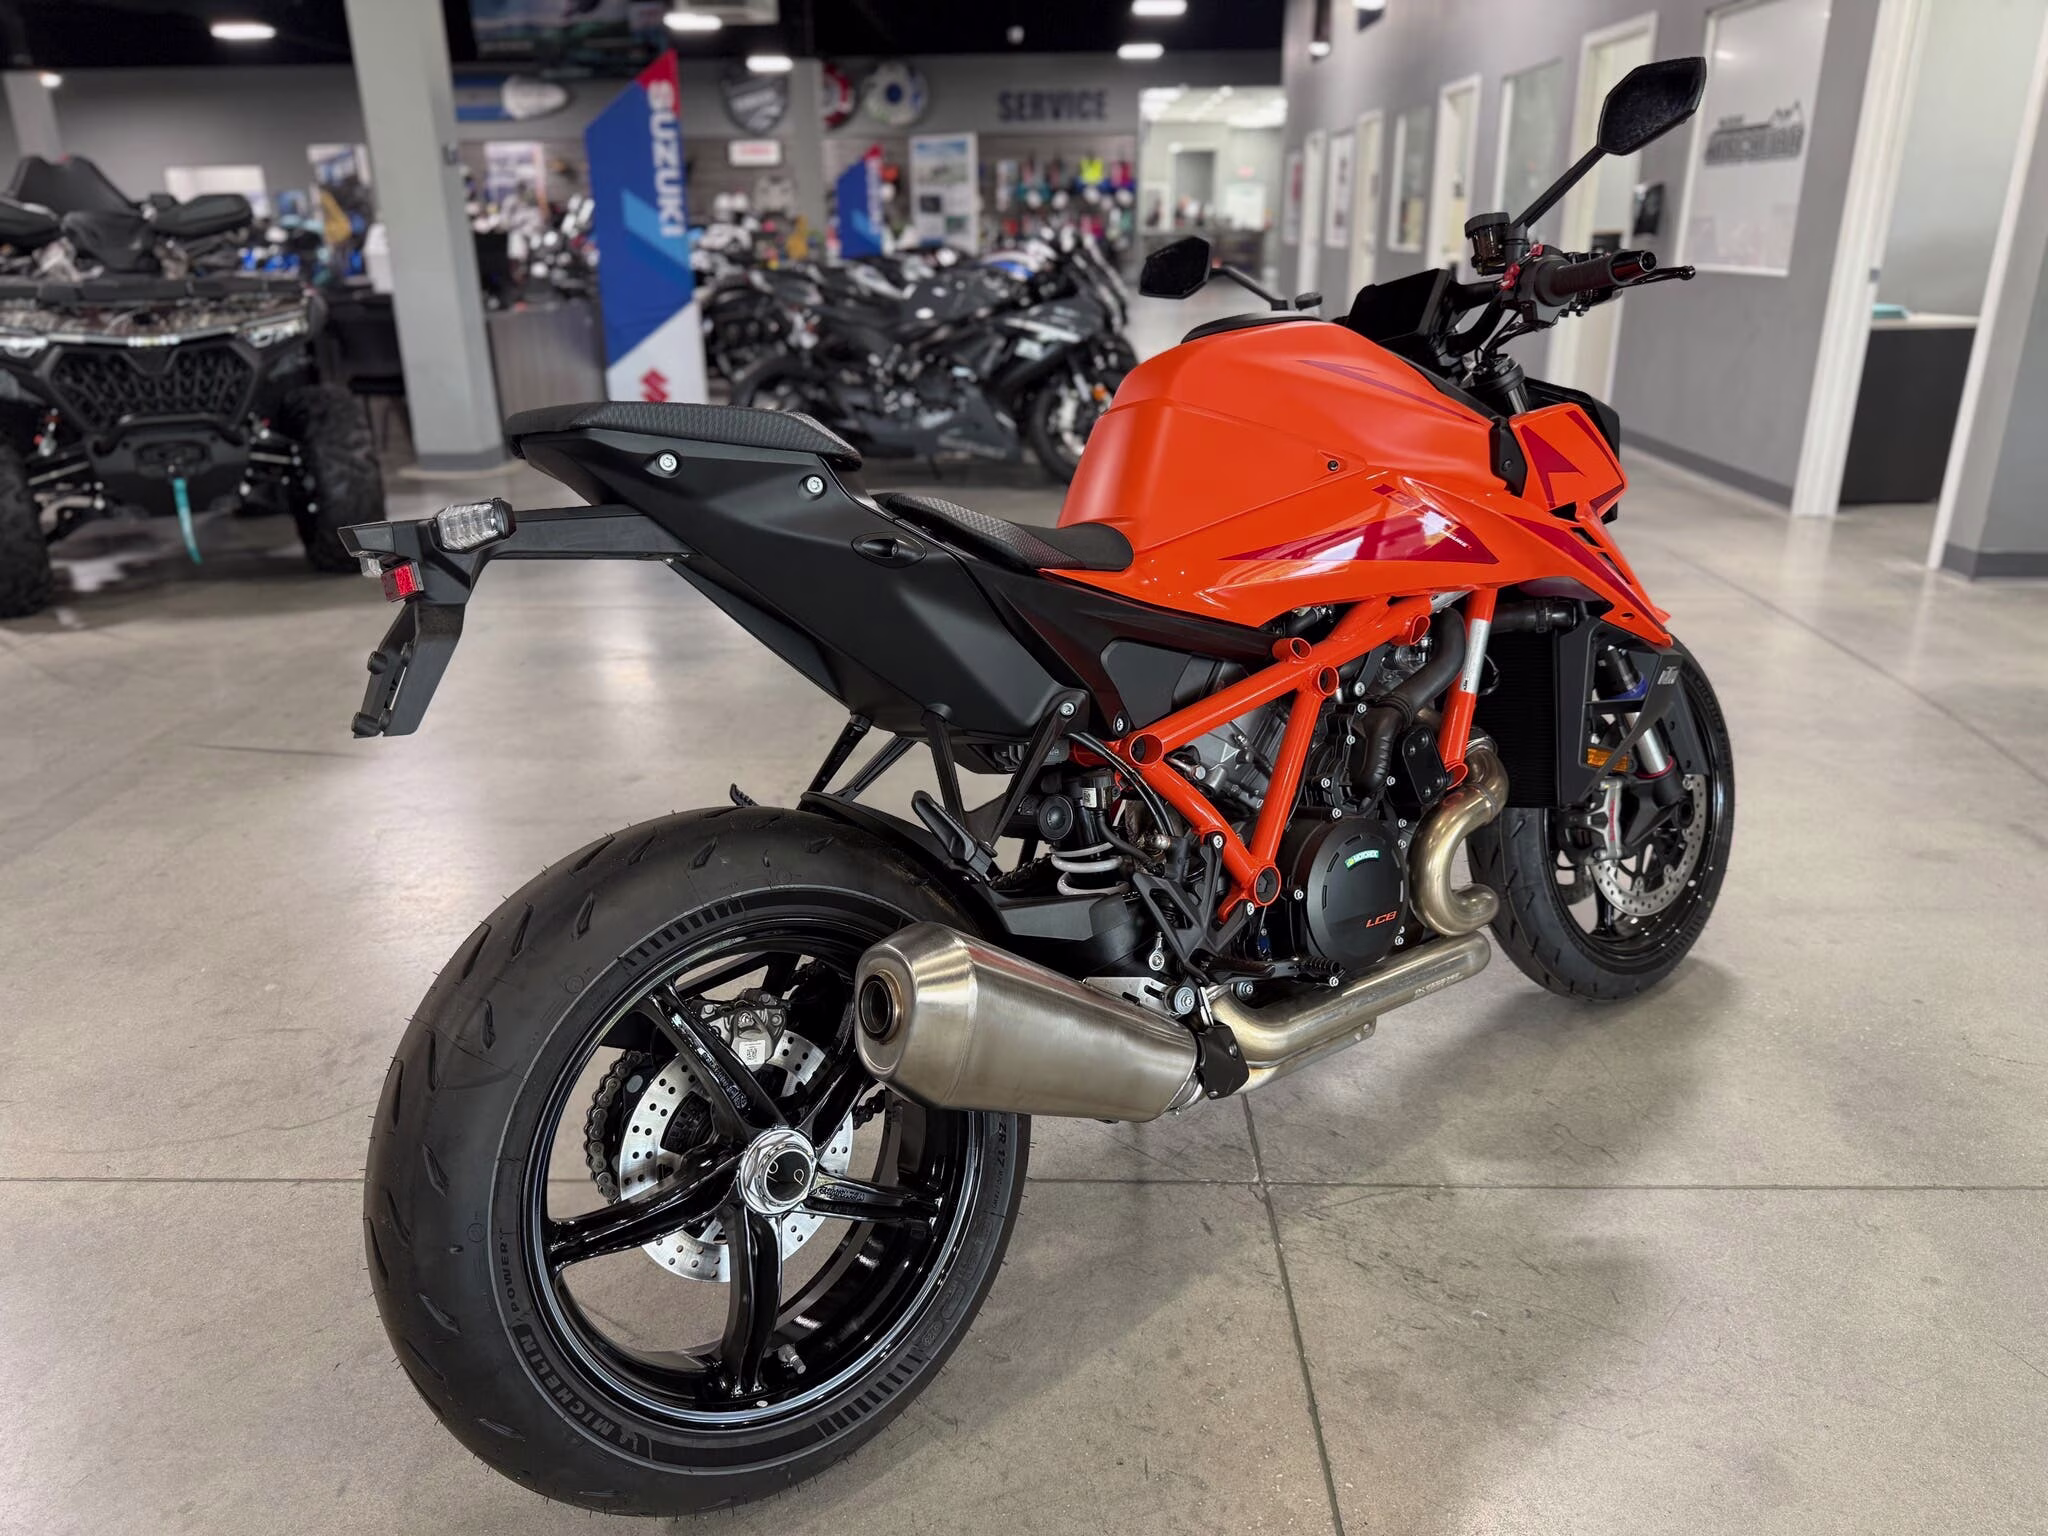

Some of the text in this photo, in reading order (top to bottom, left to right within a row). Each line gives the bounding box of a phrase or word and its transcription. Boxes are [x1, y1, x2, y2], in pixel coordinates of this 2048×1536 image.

[647, 79, 687, 238] SUZUKI
[998, 91, 1106, 121] SERVICE
[500, 1242, 616, 1437] MICHELIN POWER
